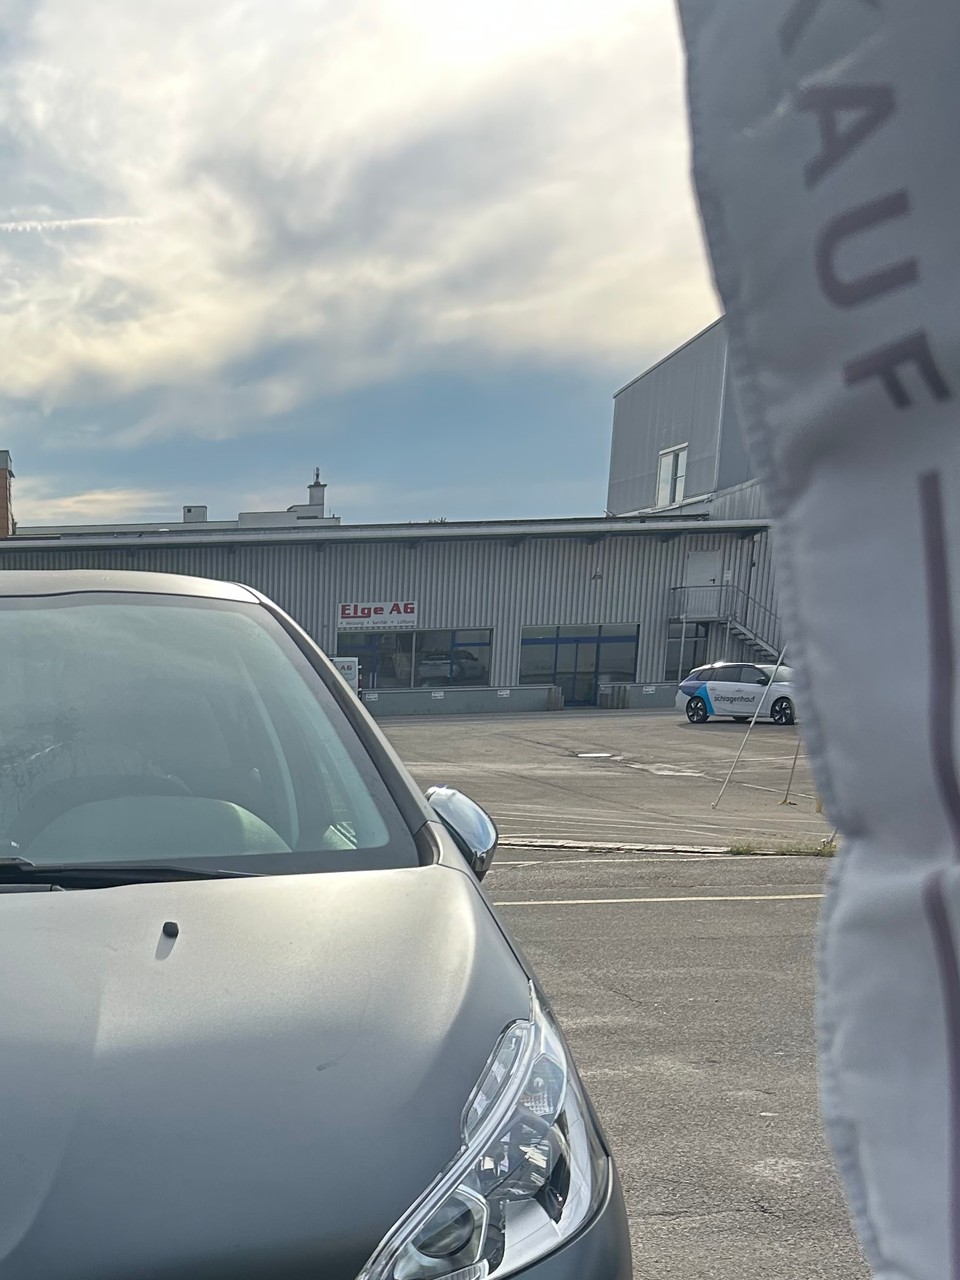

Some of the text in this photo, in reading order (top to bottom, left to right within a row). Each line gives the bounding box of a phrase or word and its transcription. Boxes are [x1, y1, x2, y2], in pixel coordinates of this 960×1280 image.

[777, 0, 952, 410] AUF
[341, 602, 415, 619] Elge AG
